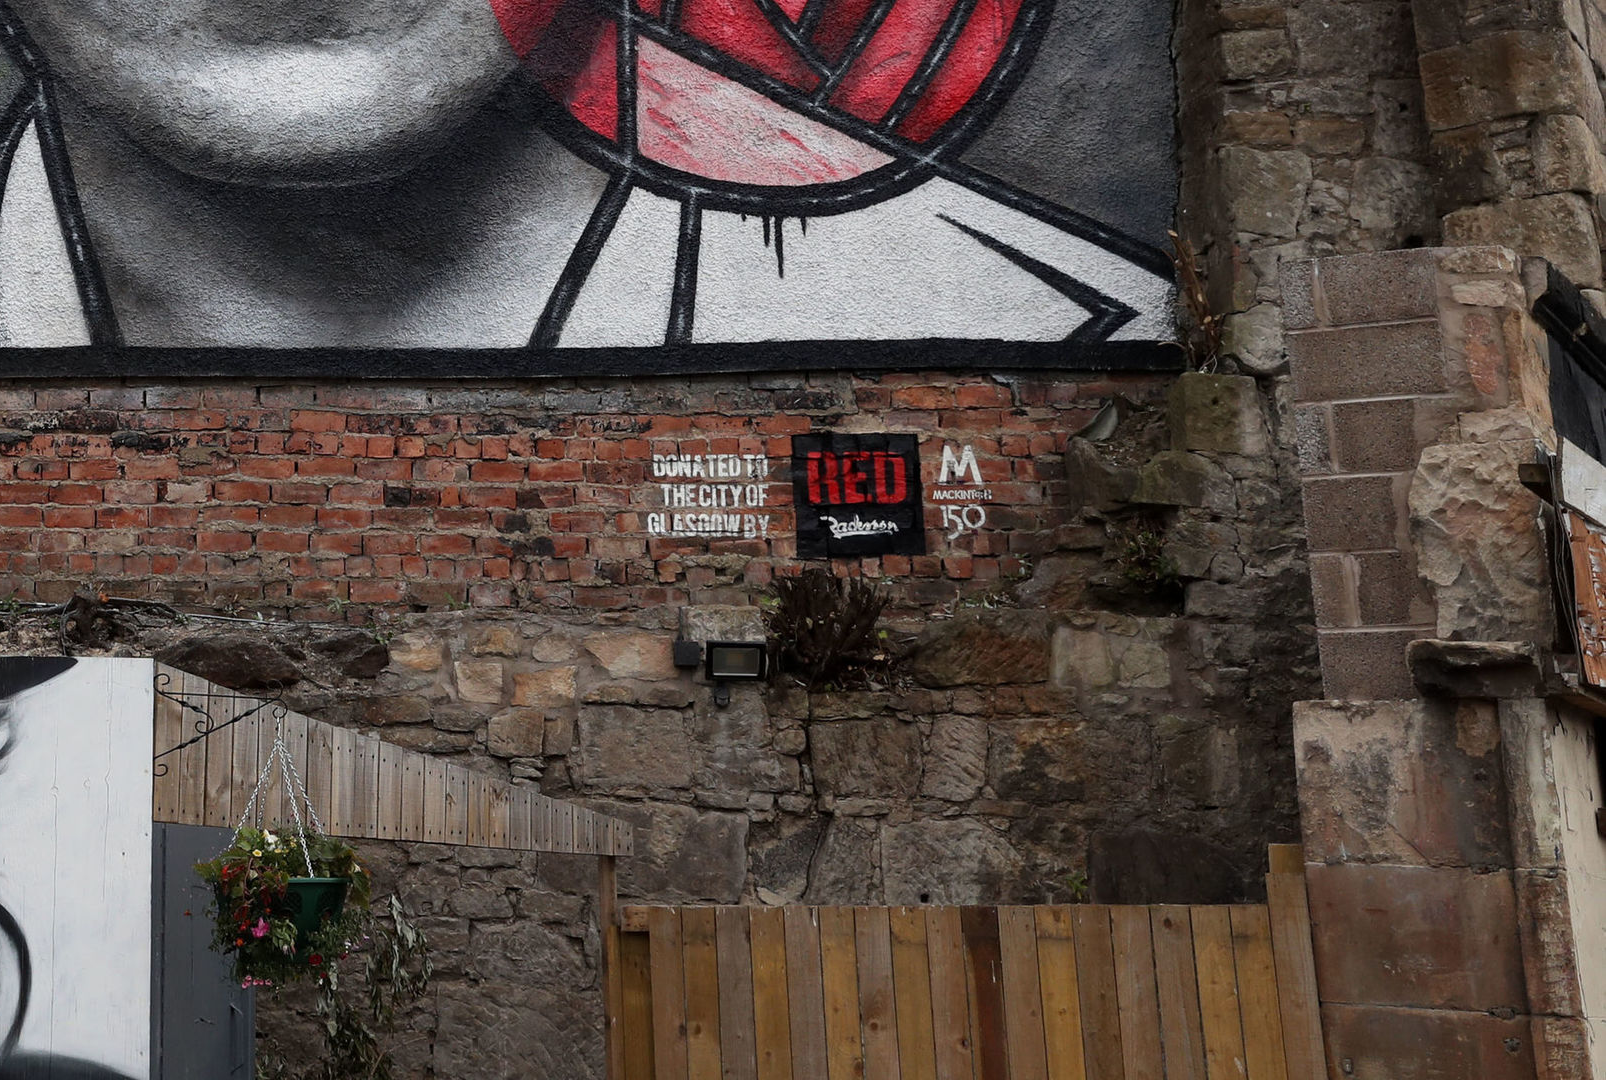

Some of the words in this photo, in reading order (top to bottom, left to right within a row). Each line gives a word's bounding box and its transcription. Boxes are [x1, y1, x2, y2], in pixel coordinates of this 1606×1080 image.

[652, 453, 741, 478] DONATED
[743, 453, 769, 478] TO
[806, 452, 907, 505] RED
[938, 445, 984, 485] M
[660, 483, 697, 507] THE
[698, 483, 743, 507] CITY
[745, 483, 770, 507] OF
[647, 513, 741, 537] GLASGOW
[743, 514, 770, 539] BY
[939, 504, 986, 540] 150
